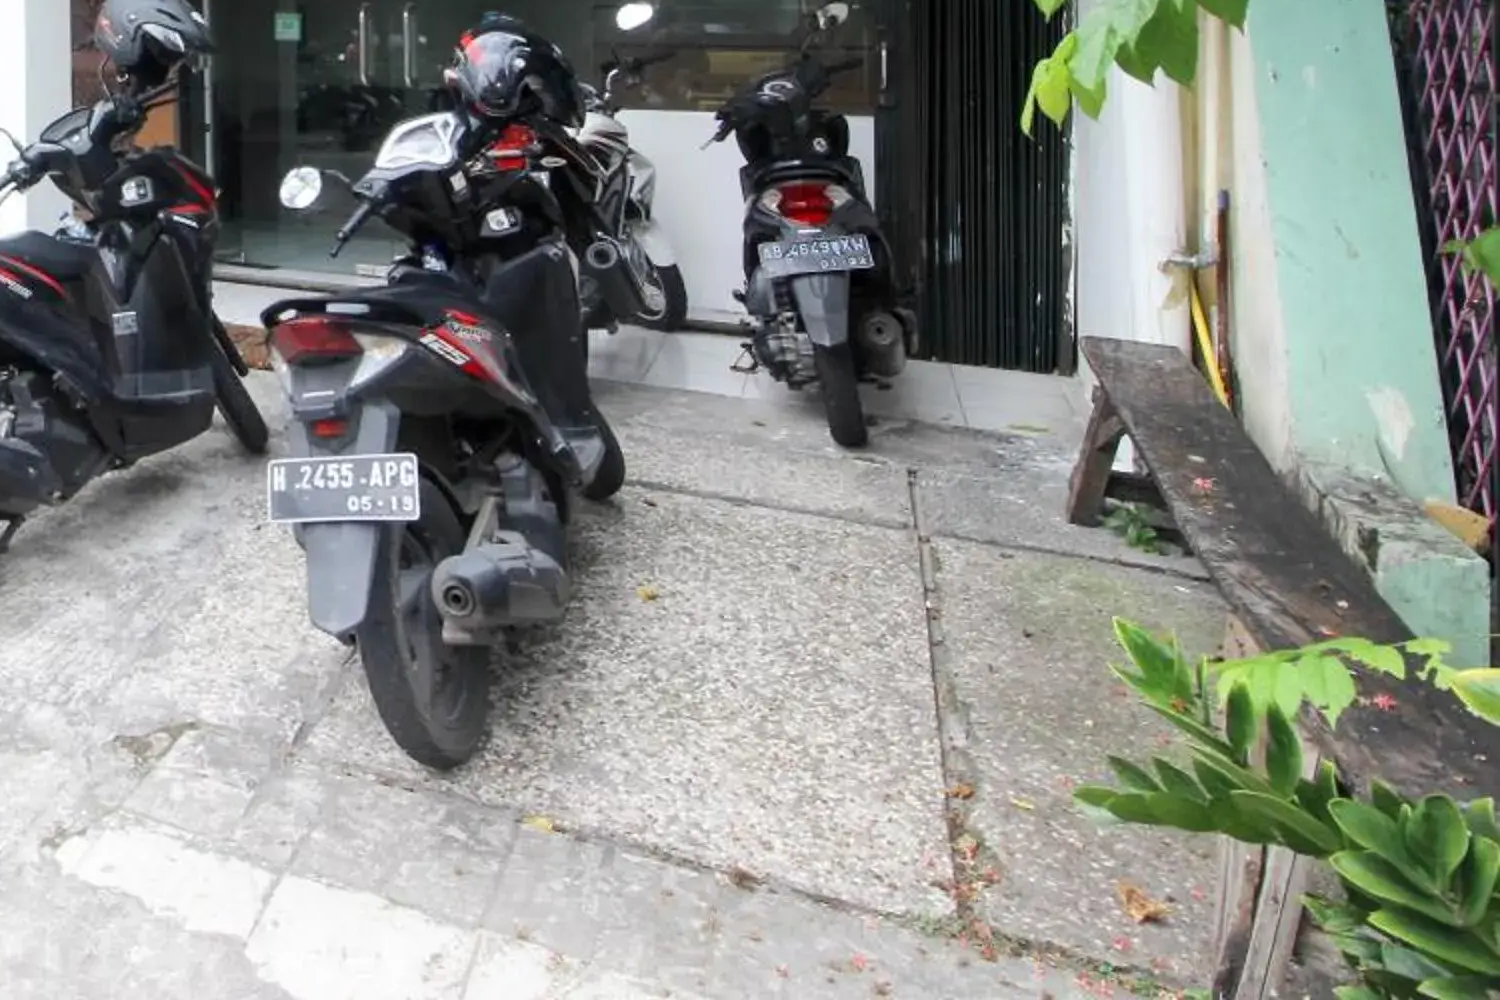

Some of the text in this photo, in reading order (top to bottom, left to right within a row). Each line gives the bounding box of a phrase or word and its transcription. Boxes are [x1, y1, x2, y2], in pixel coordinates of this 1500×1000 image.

[273, 460, 414, 491] H 2455 APG
